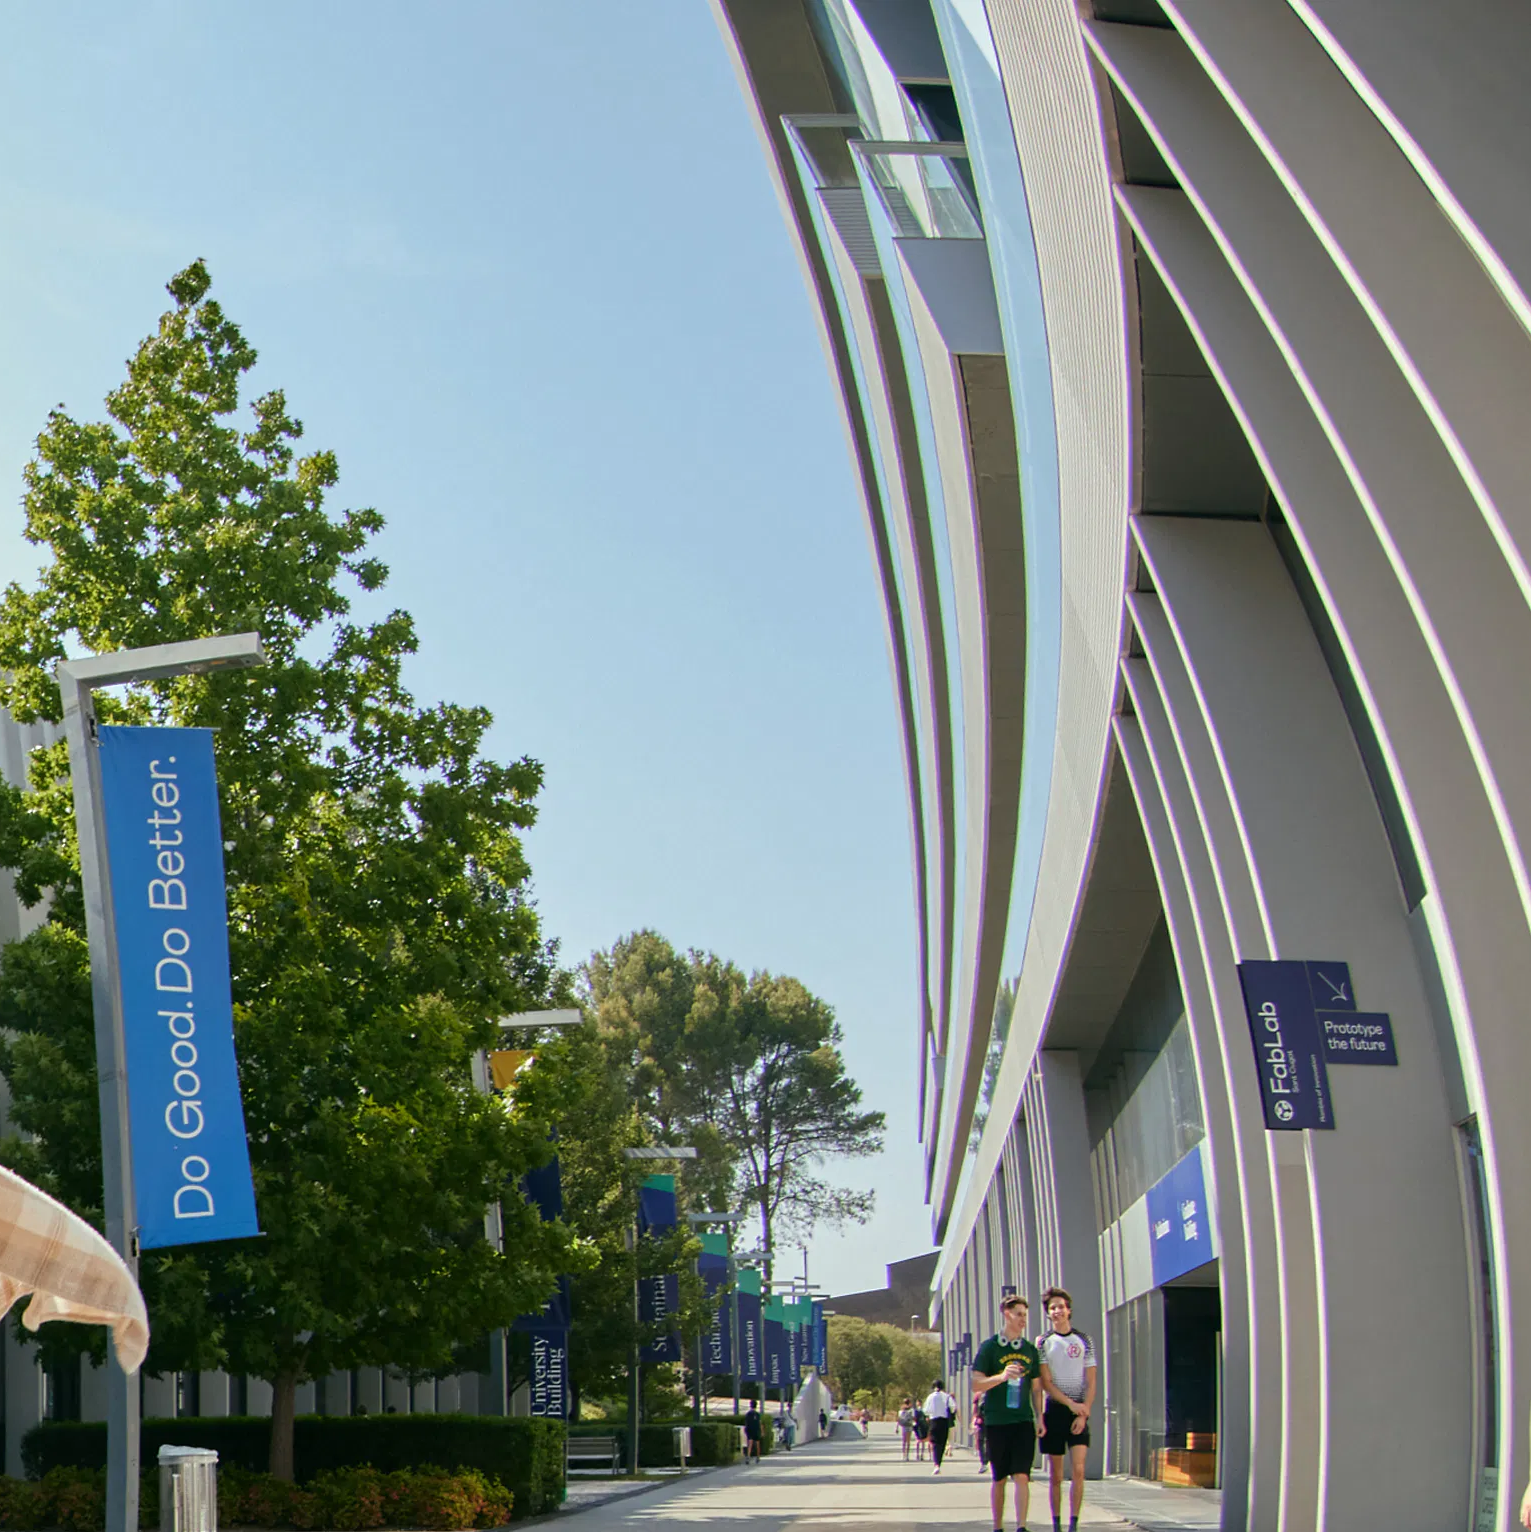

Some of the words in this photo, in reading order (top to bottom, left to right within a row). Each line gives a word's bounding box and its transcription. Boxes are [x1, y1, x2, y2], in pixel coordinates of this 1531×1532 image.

[148, 755, 188, 910] Better.
[155, 928, 193, 994] Do
[1257, 1001, 1291, 1093] FabLab
[1324, 1020, 1383, 1037] Prototype
[1327, 1038, 1347, 1050] the
[1350, 1037, 1386, 1051] future
[173, 1155, 215, 1219] Do
[531, 1336, 549, 1416] University
[745, 1320, 757, 1376] Innovation
[770, 1353, 781, 1384] Impact
[547, 1348, 565, 1416] Building
